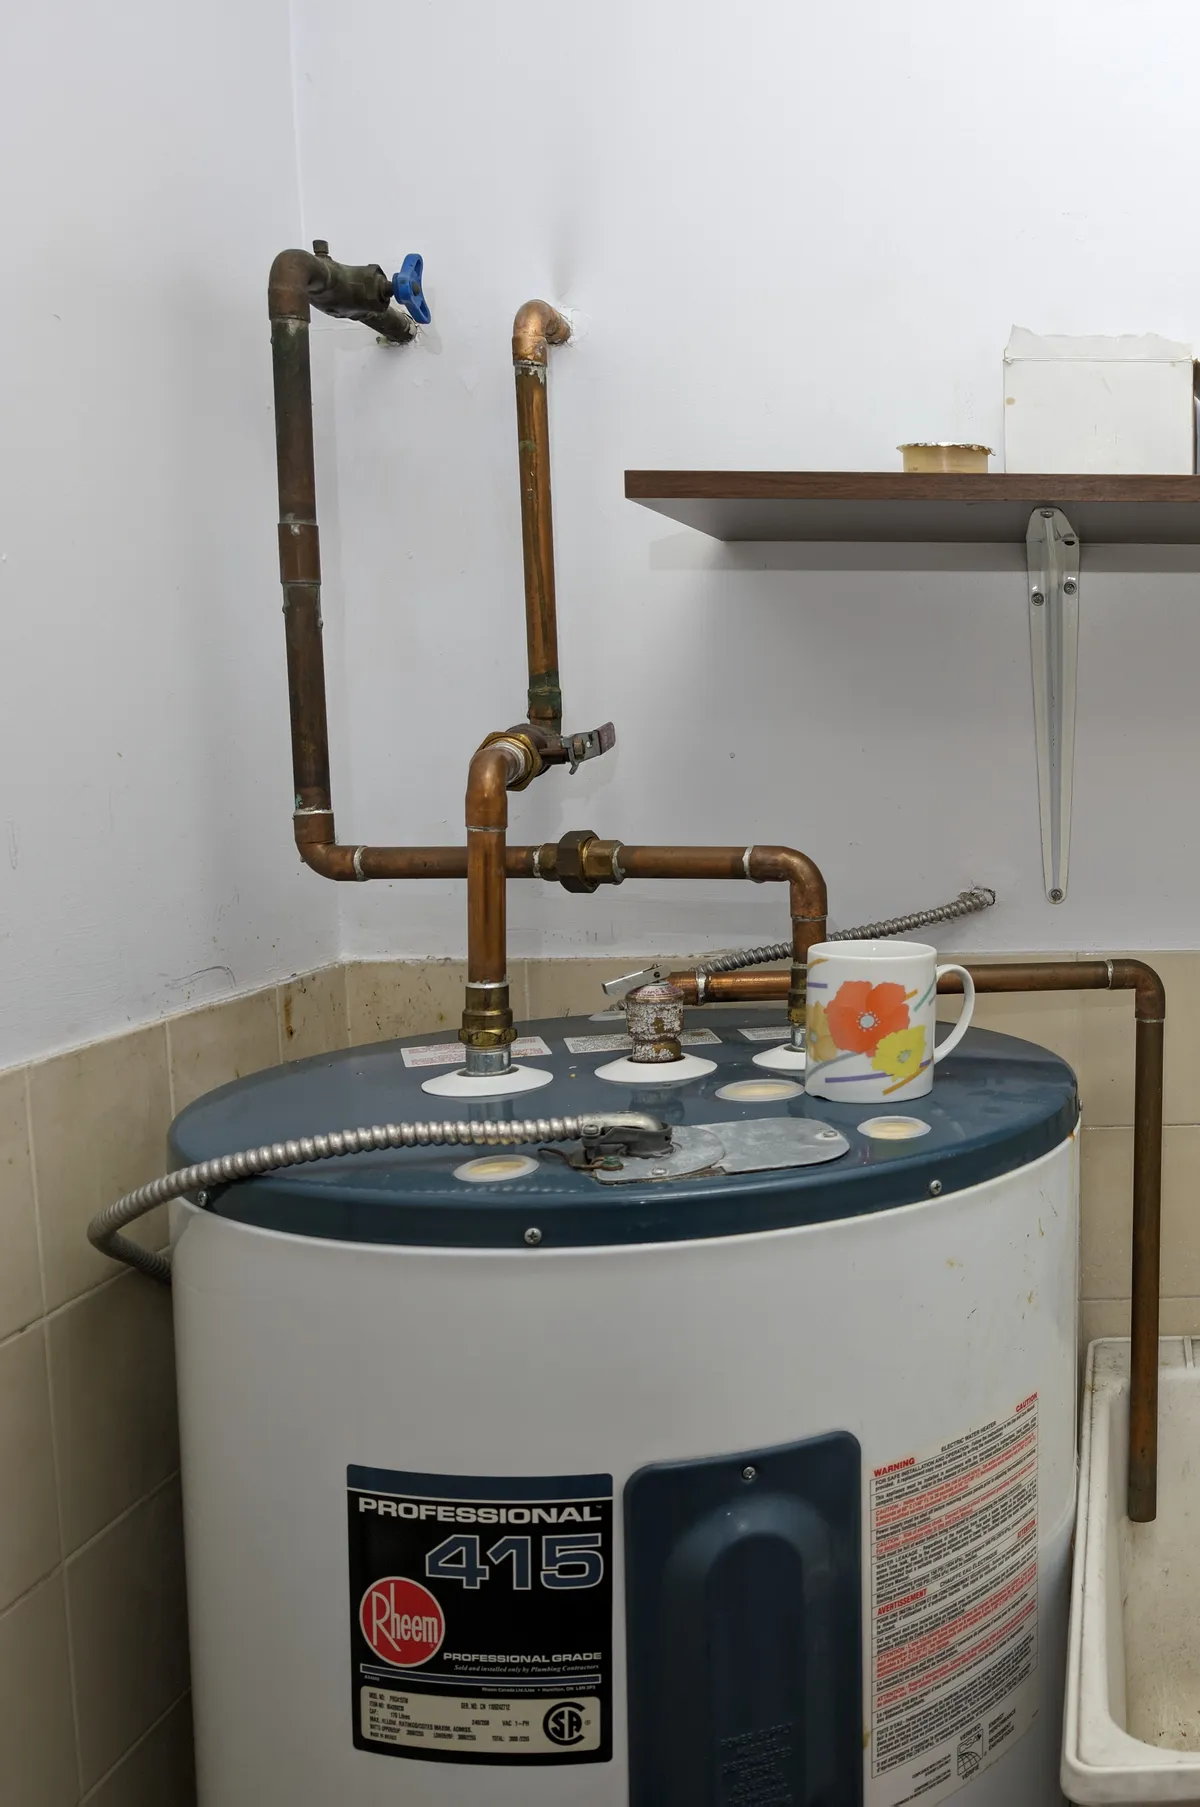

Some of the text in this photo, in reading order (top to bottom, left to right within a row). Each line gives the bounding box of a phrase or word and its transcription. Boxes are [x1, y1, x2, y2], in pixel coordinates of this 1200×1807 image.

[1016, 1390, 1037, 1414] CAUTION
[941, 1420, 996, 1451] ELECTRIC WATER HEATER
[874, 1457, 914, 1477] WARNING
[875, 1477, 885, 1486] FOR
[886, 1473, 899, 1482] SAFE
[900, 1459, 933, 1477] INSTALLATION
[359, 1497, 602, 1524] PROFESSIONAL
[426, 1533, 604, 1591] 415
[940, 1571, 960, 1587] CHAUFFE
[877, 1587, 926, 1615] AVERTISSEMENT
[371, 1583, 439, 1652] Rheem
[443, 1652, 602, 1663] PROFESSIONAL GRADE
[531, 1665, 561, 1673] Plumbing
[562, 1664, 599, 1672] Contractors
